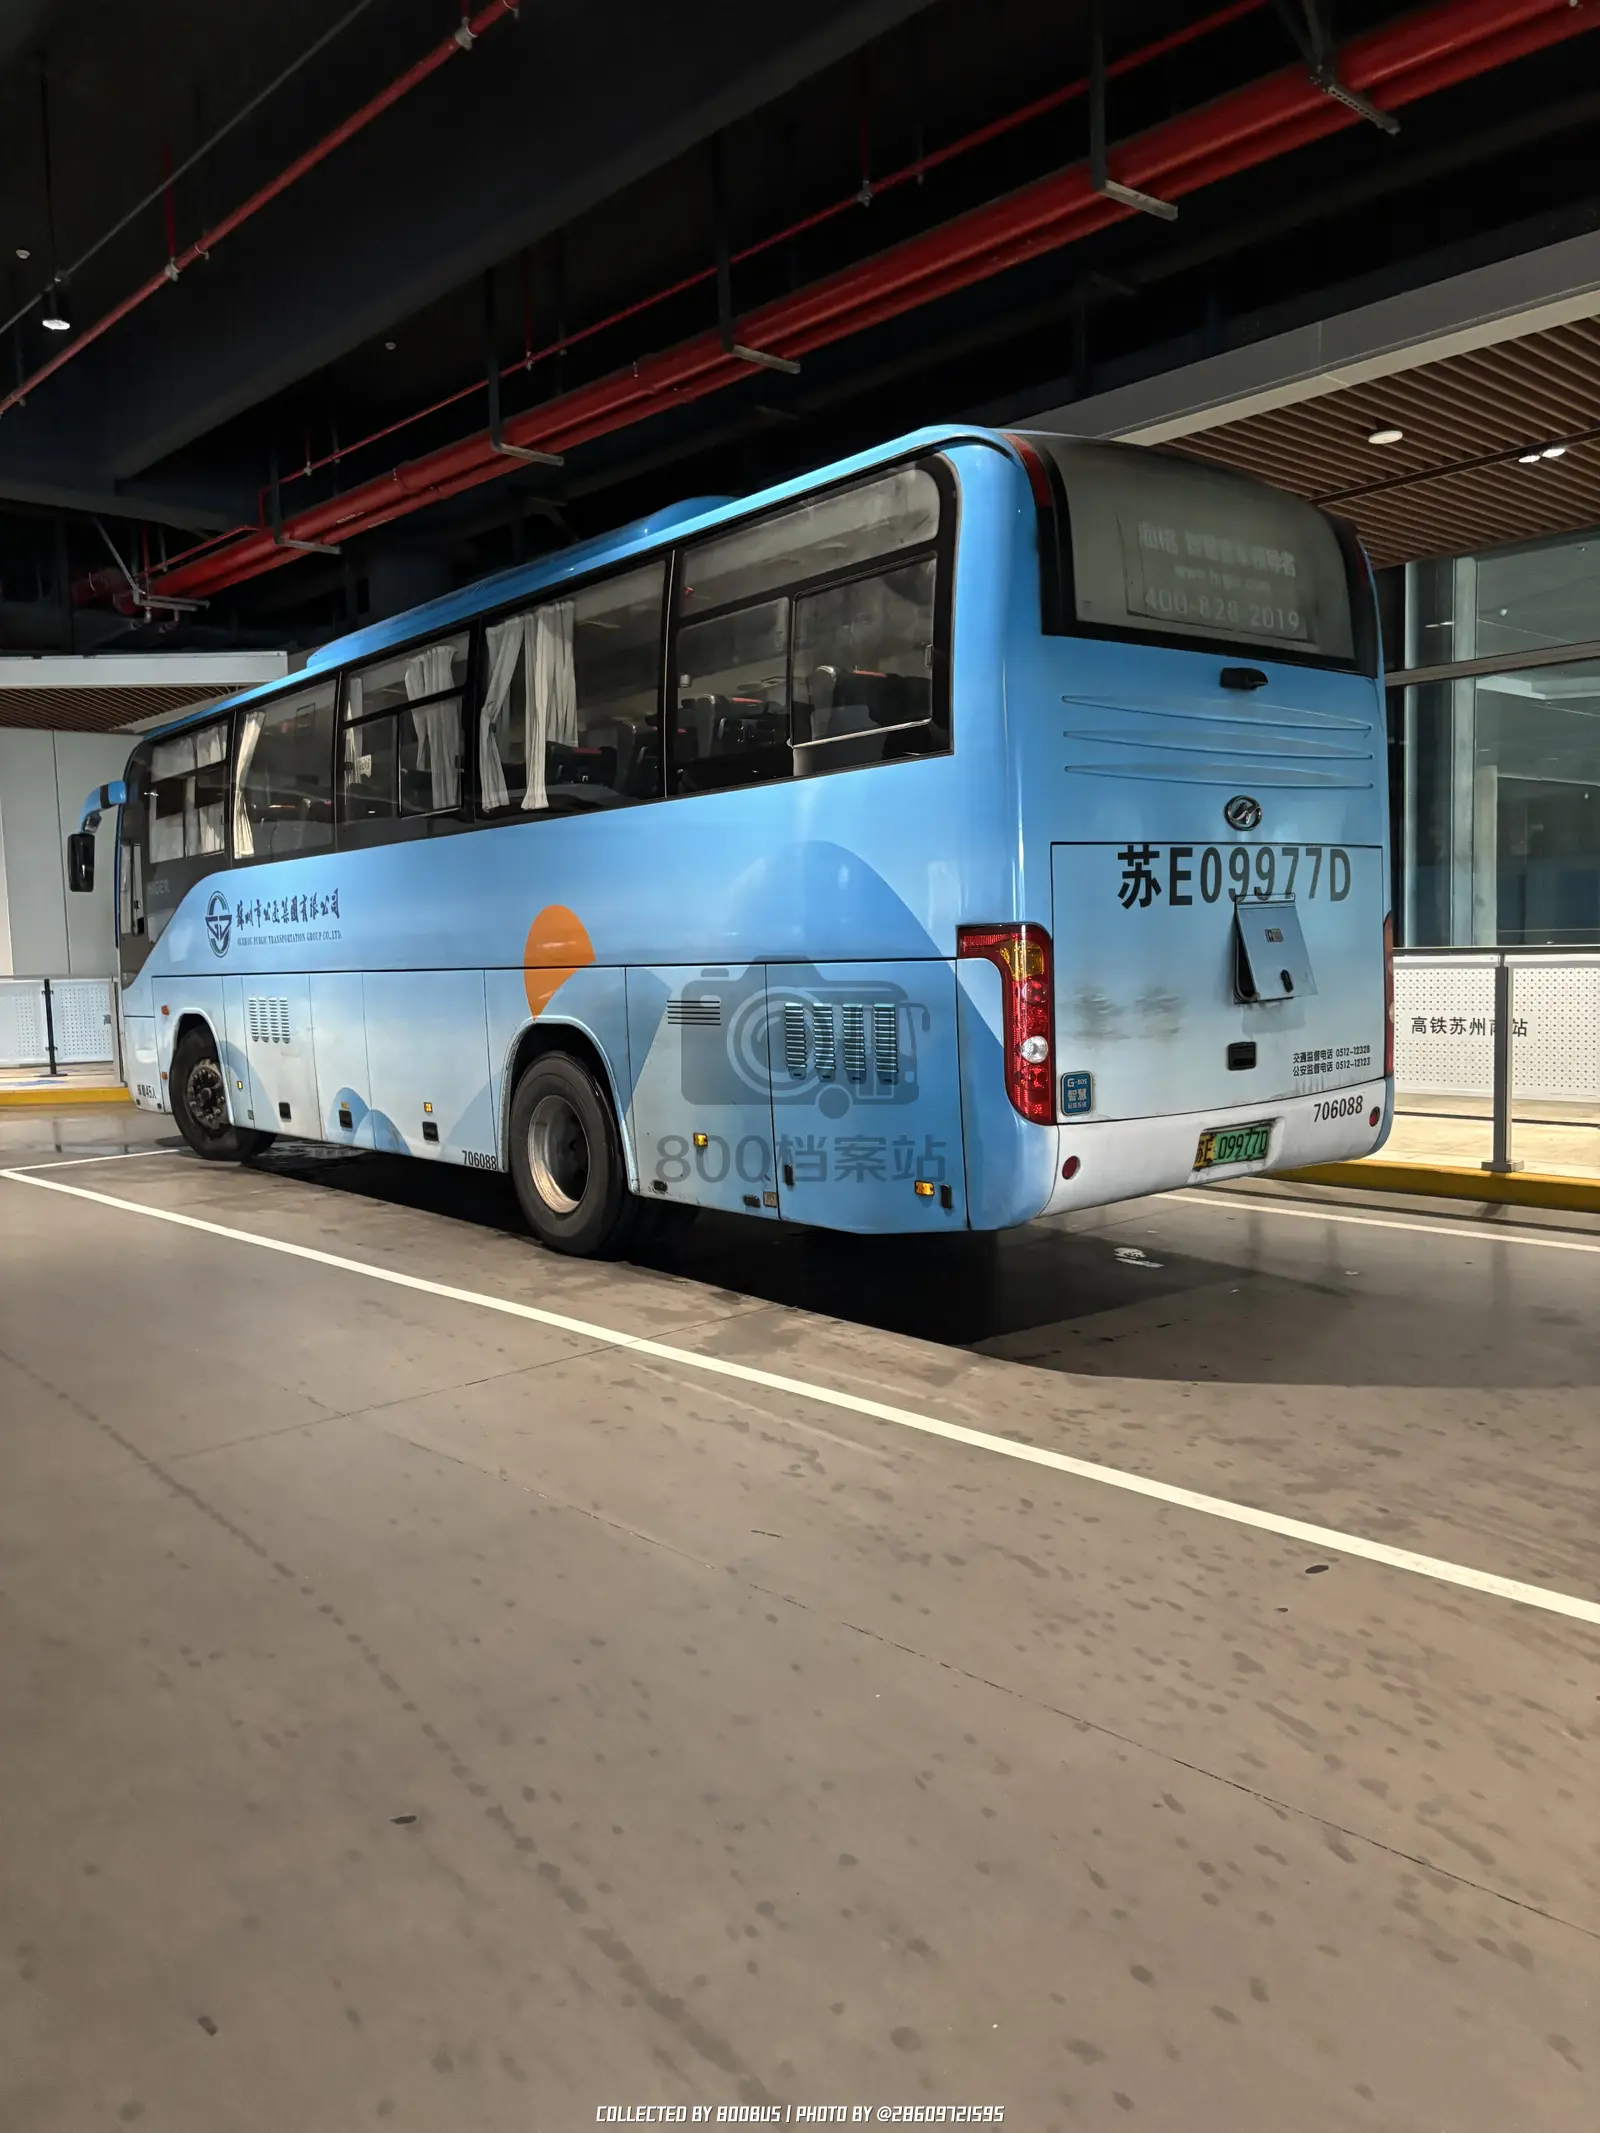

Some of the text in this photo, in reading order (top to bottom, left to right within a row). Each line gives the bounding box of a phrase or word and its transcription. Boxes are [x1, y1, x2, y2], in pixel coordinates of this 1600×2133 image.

[1117, 844, 1351, 910] 苏E09977D
[306, 931, 322, 941] GROUP
[1293, 1049, 1333, 1064] 交通监督电话
[1293, 1057, 1371, 1077] 公安监督电话 0512-12123
[1314, 1095, 1363, 1123] 706088
[461, 1149, 497, 1171] 706088
